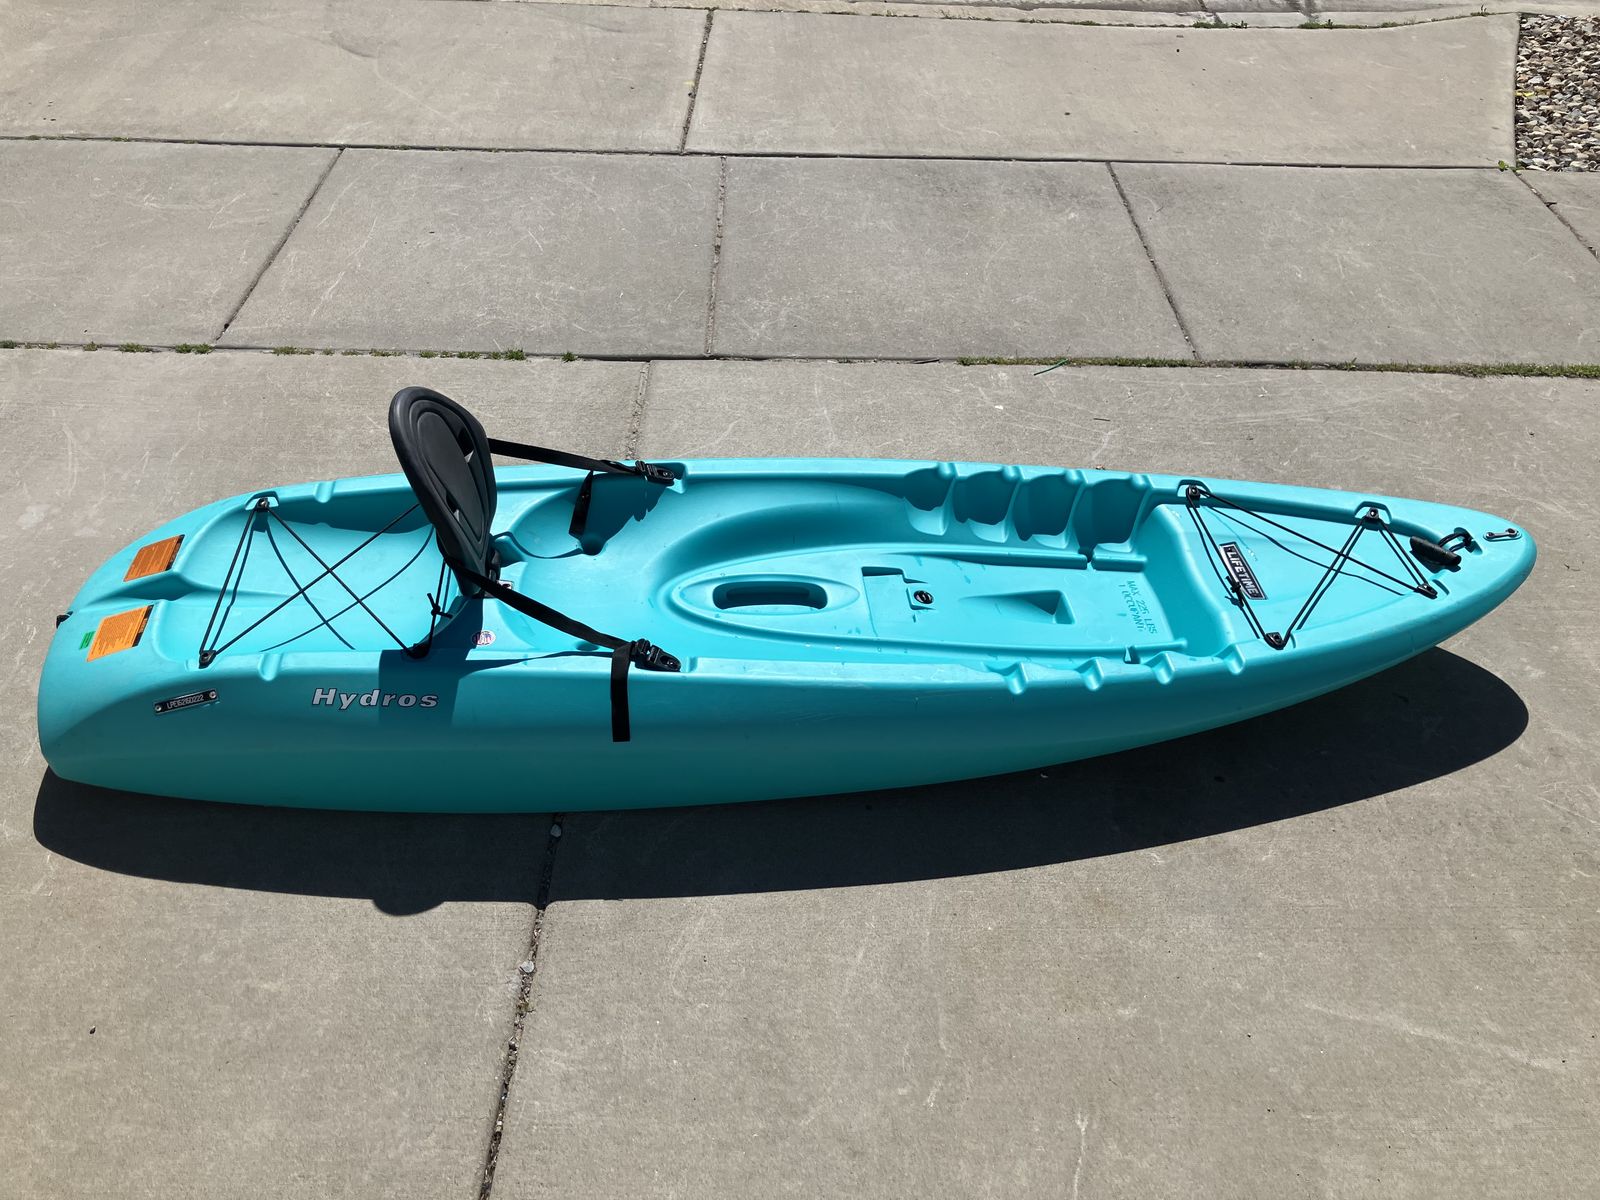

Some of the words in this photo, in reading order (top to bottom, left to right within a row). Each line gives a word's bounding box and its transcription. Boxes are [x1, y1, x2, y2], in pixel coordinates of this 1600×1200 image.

[1226, 551, 1260, 595] LIFETIME
[1127, 580, 1141, 596] MAX
[1143, 618, 1158, 634] LBS
[311, 687, 440, 711] Hydros
